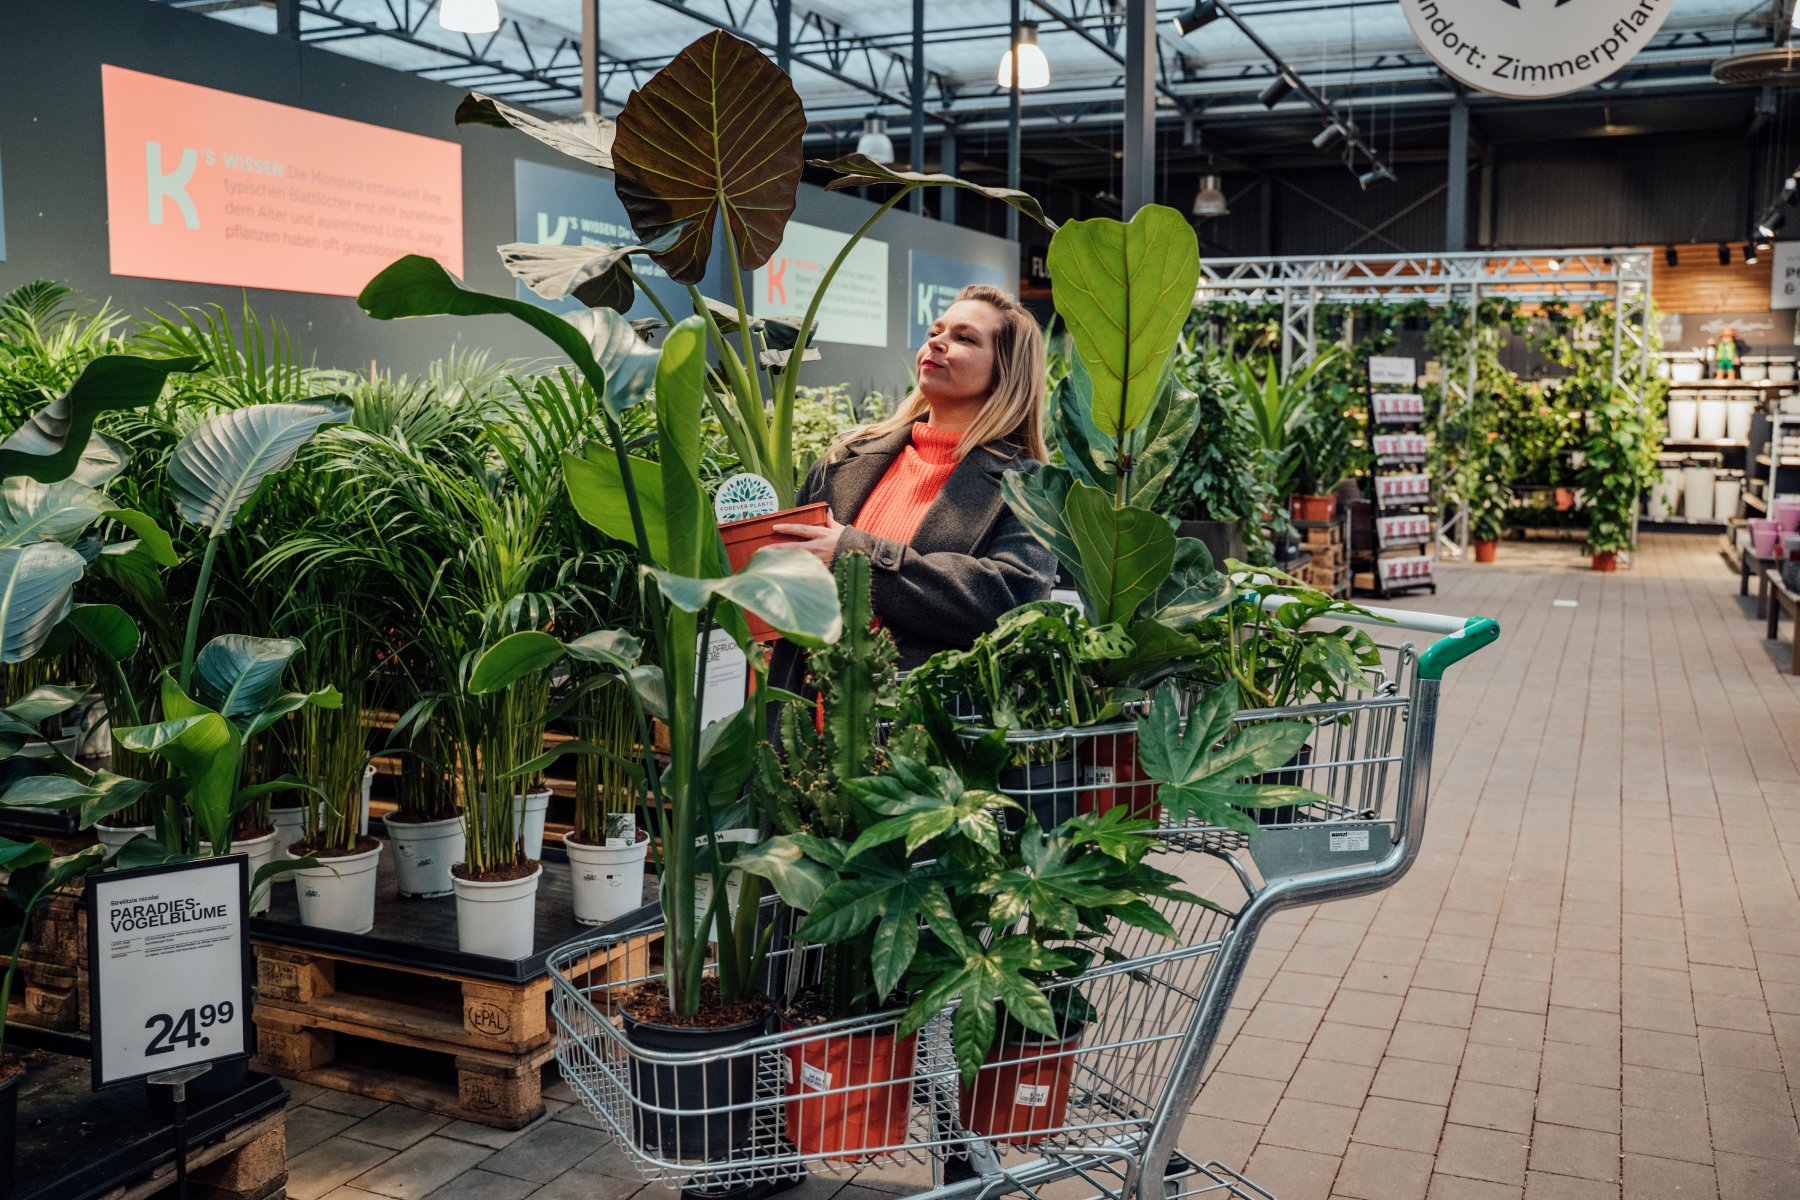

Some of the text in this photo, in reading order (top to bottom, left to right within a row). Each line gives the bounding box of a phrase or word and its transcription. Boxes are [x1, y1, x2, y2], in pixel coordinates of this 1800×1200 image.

[1418, 0, 1486, 69] ndort:
[223, 153, 284, 178] WISSEN
[287, 165, 307, 182] Die
[310, 170, 364, 192] Monstera
[223, 178, 286, 200] typischen
[225, 201, 255, 218] dem
[258, 205, 288, 222] Alter
[290, 209, 314, 227] und
[225, 225, 280, 243] pflanzen
[283, 231, 320, 249] haben
[322, 236, 340, 251] oft
[720, 504, 748, 512] FOREVER
[110, 893, 160, 907] Strelitzia nicolai
[110, 897, 201, 922] PARADIES-
[110, 904, 228, 933] VOGELBLUME
[475, 1010, 505, 1030] EPAL
